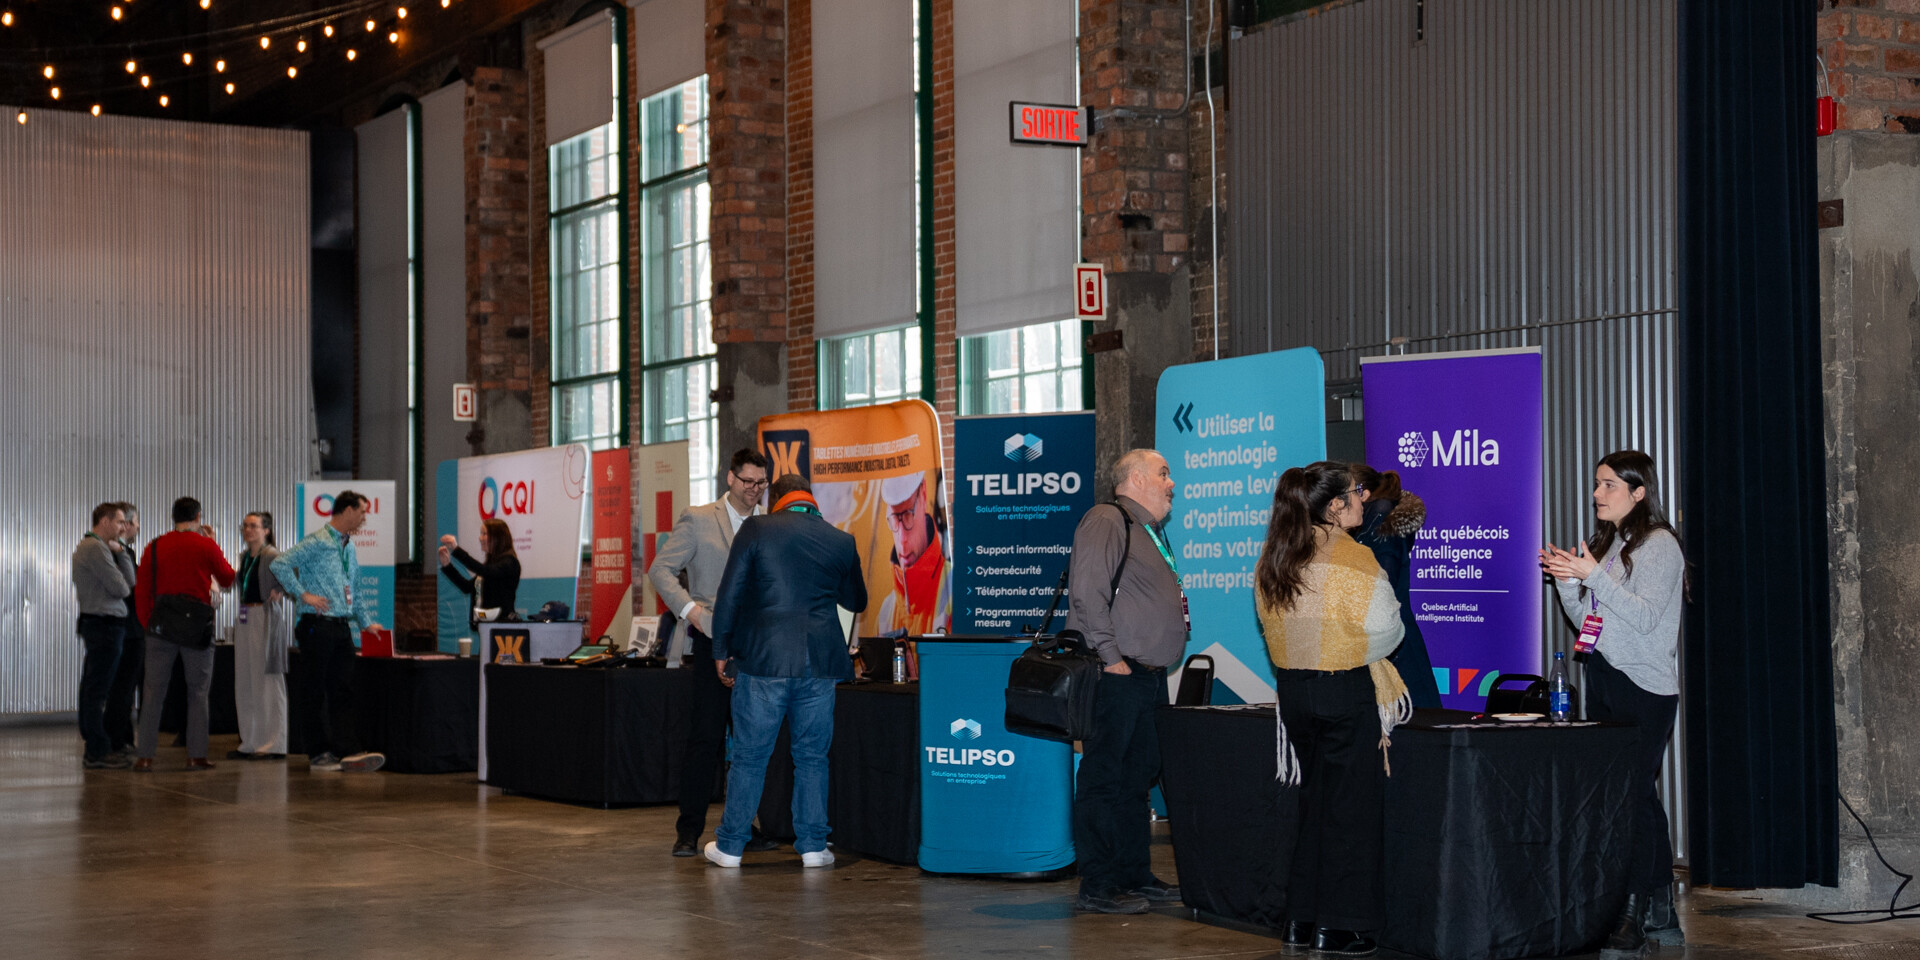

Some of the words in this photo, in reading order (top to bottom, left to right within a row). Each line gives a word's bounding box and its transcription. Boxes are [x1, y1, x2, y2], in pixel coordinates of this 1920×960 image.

[1022, 107, 1080, 141] SORTIE
[1197, 413, 1255, 438] Utiliser
[1258, 412, 1275, 431] la
[1184, 441, 1277, 469] technologie
[1432, 429, 1500, 467] Mila
[813, 463, 827, 475] HIGH
[966, 471, 1082, 496] TELIPSO
[1183, 478, 1243, 500] comme
[1247, 471, 1278, 495] levi
[501, 479, 535, 516] CQI
[975, 505, 1012, 513] Solutions
[1012, 503, 1071, 513] technologiques
[1008, 511, 1048, 521] entreprise
[1183, 504, 1273, 533] d'optimisa
[1440, 525, 1510, 543] québécois
[354, 538, 378, 547] ussir.
[975, 545, 1014, 557] Support
[1016, 544, 1072, 556] informatiqu
[1182, 539, 1223, 559] dans
[1225, 536, 1264, 557] votr
[1408, 545, 1493, 563] 'intelligence
[975, 565, 1042, 577] Cybersécurité
[1416, 564, 1483, 579] artificielle
[1182, 566, 1254, 593] entrepris
[975, 586, 1027, 597] Téléphonie
[975, 607, 1051, 619] Programmatio
[1422, 602, 1447, 612] Quebec
[1449, 602, 1478, 611] Artificial
[975, 620, 1011, 628] mesure
[1415, 613, 1454, 623] Intelligence
[1455, 613, 1485, 622] Institute
[925, 746, 1015, 766] TELIPSO
[958, 772, 1006, 780] technologiques
